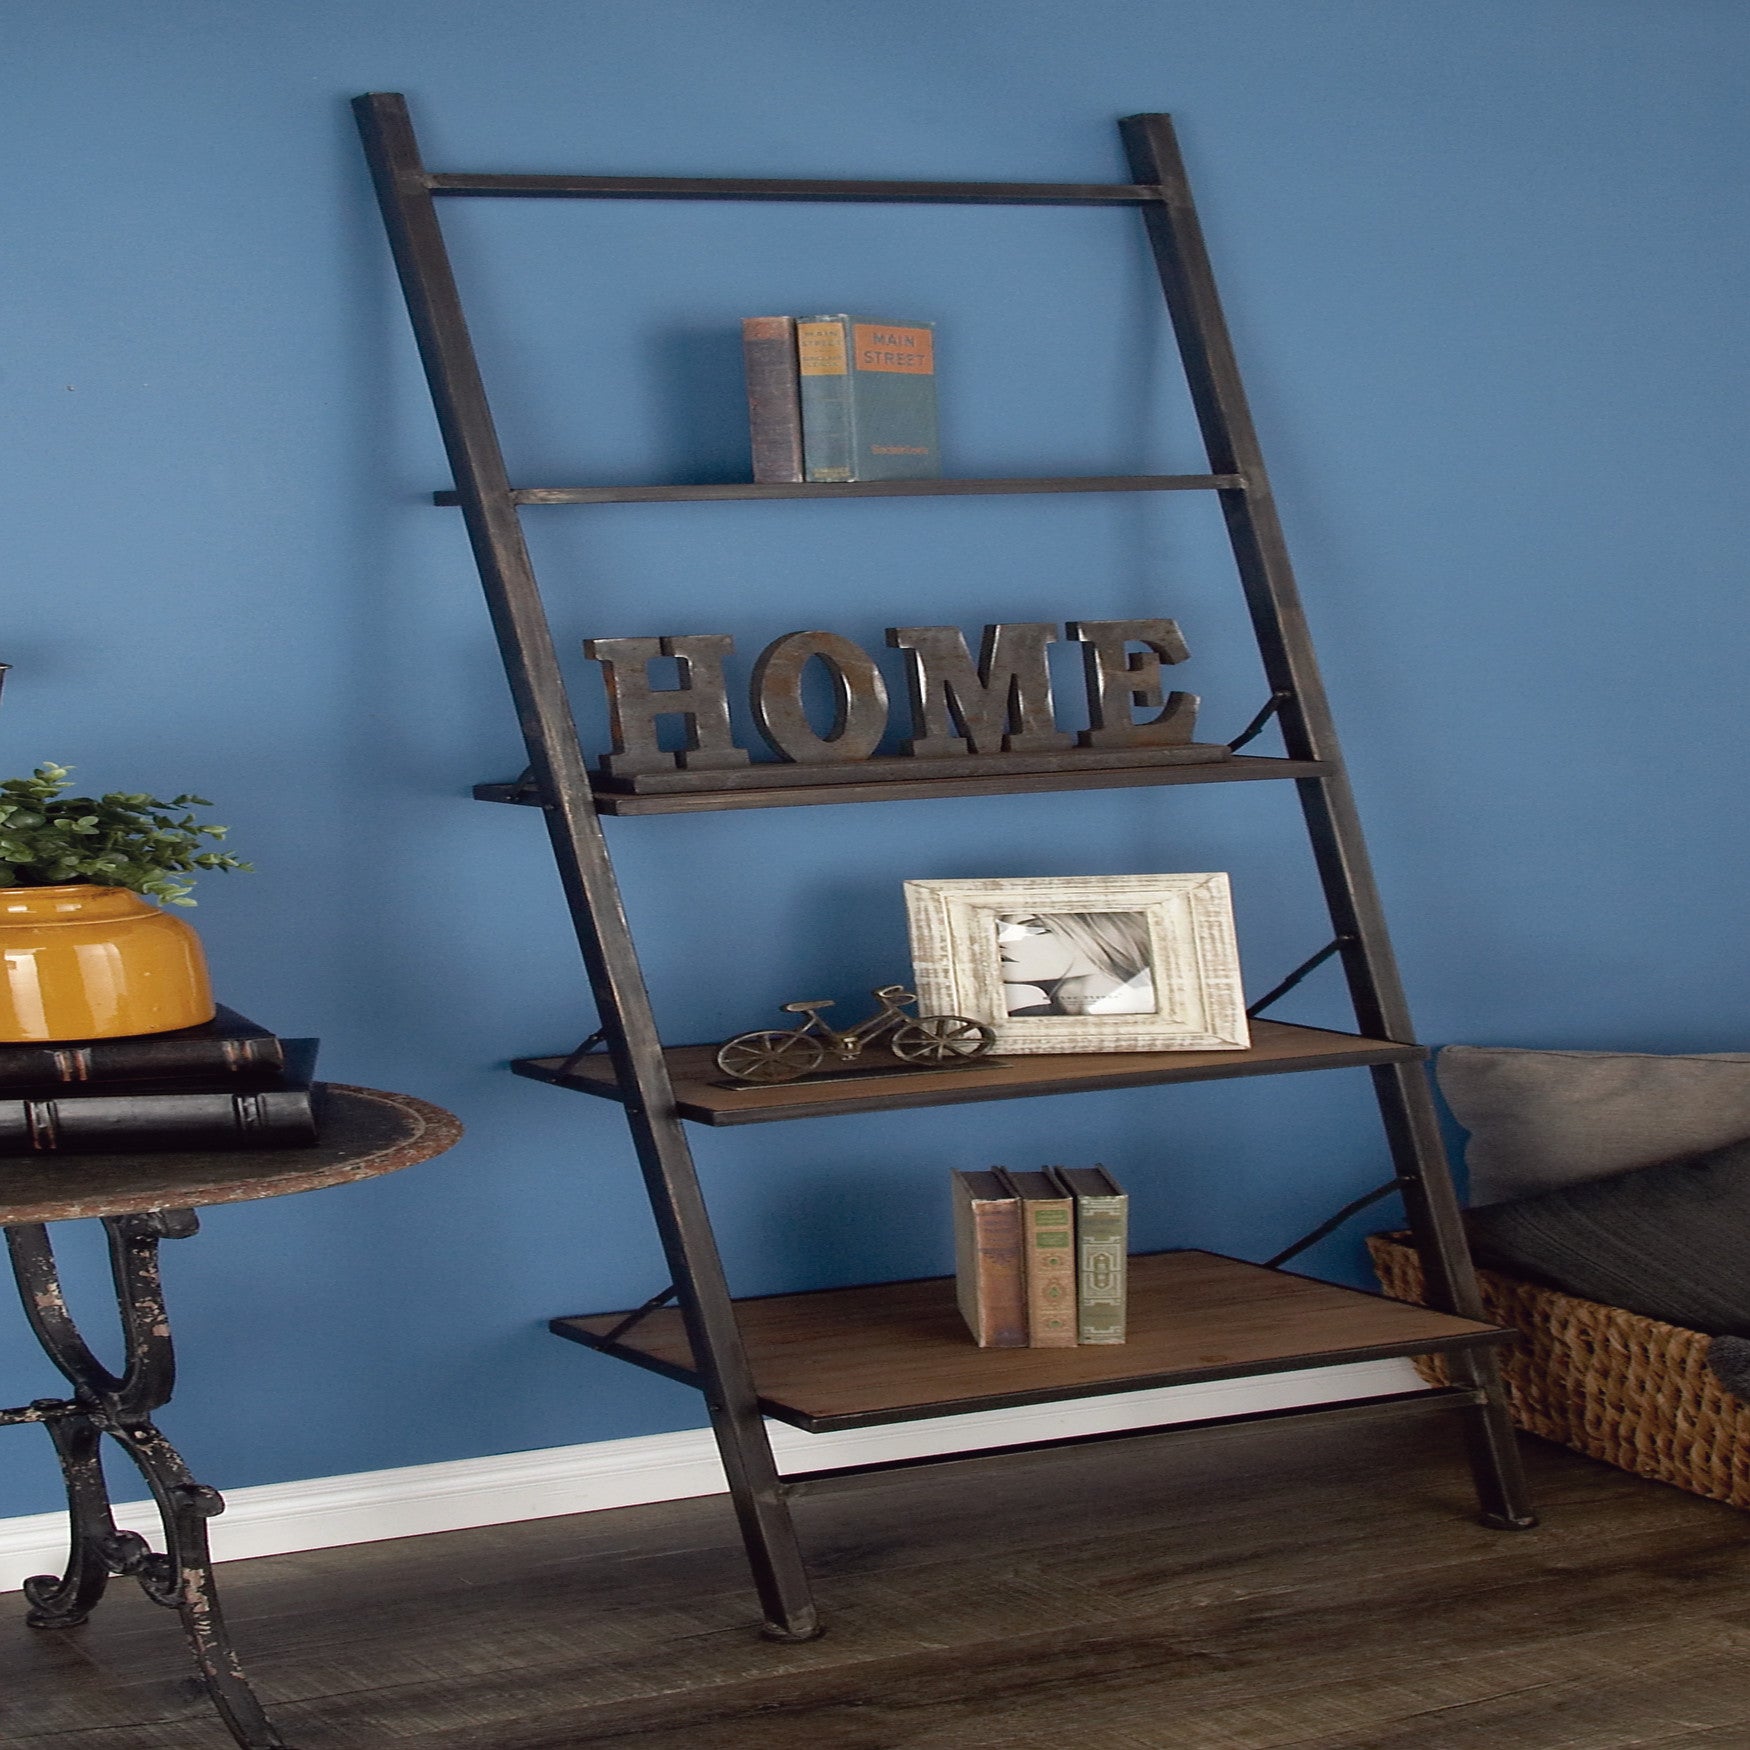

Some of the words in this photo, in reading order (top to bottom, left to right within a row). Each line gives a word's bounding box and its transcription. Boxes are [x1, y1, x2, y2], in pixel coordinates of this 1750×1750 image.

[873, 332, 915, 347] MAIN
[864, 350, 925, 367] STREET
[584, 618, 1201, 773] HOME
